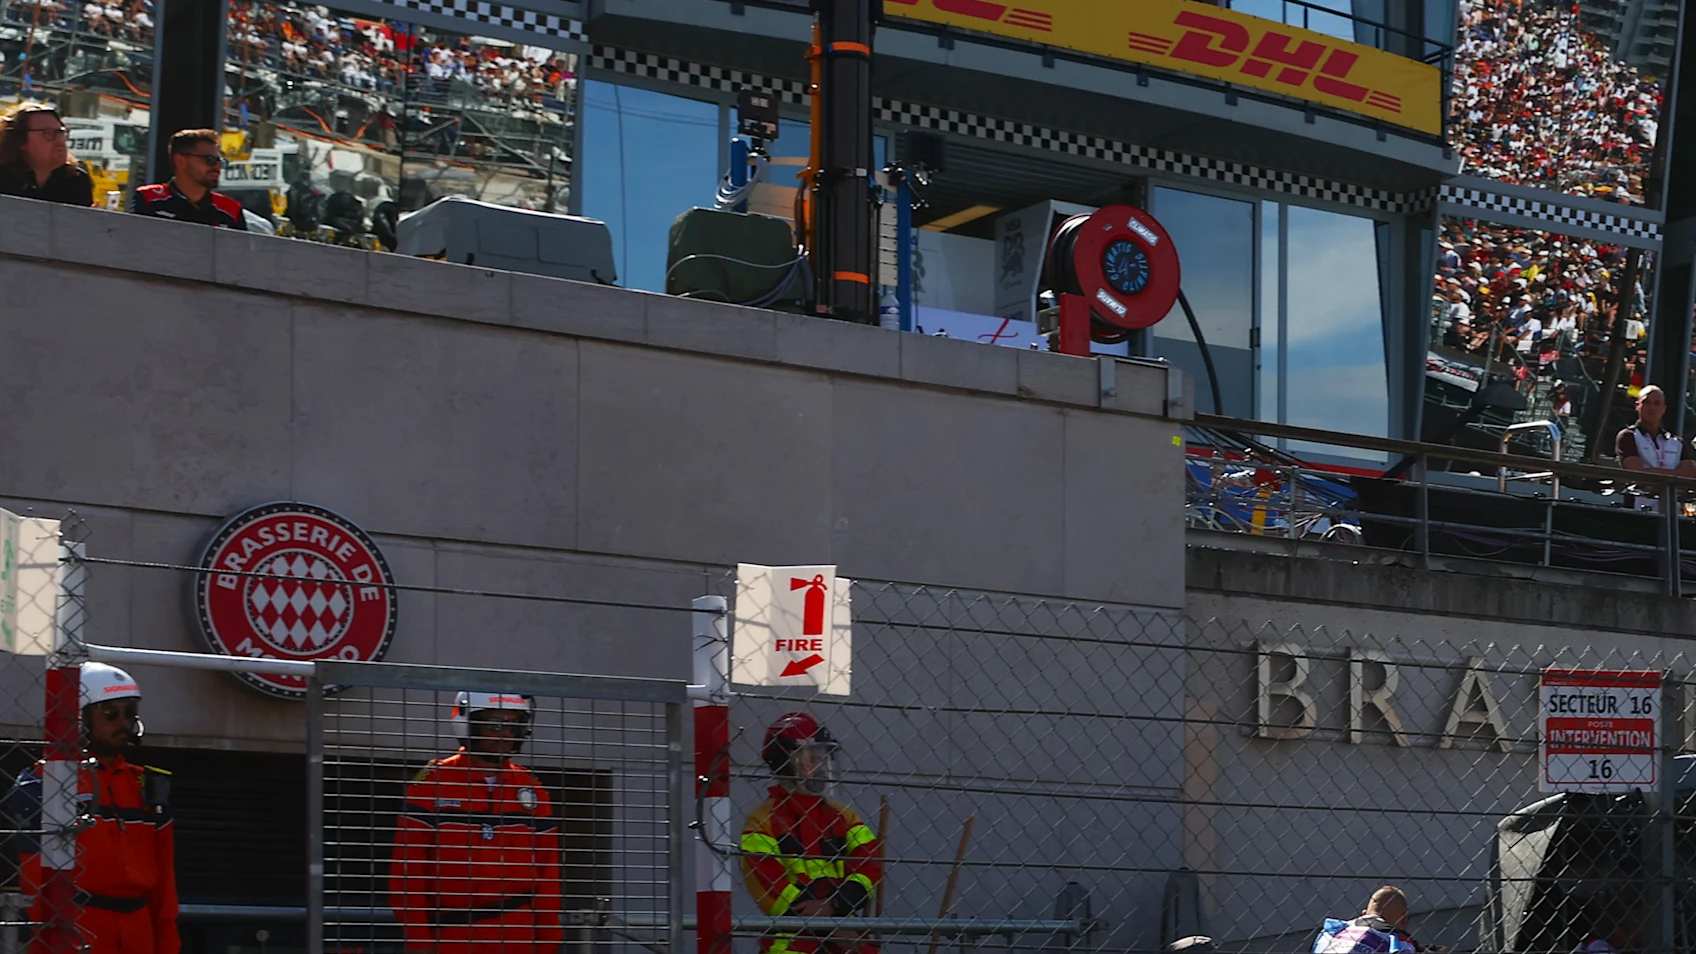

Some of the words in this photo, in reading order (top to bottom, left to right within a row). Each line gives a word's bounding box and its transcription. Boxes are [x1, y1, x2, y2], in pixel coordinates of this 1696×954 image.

[1170, 10, 1370, 102] DHL
[215, 521, 358, 591] BRASSERIE
[350, 563, 381, 603] DE
[775, 638, 824, 652] FIRE
[1549, 694, 1618, 714] SECTEUR
[1630, 696, 1652, 714] 16
[1587, 720, 1614, 729] POSTE
[1549, 729, 1652, 749] INTERVENTION
[1589, 759, 1612, 779] 16
